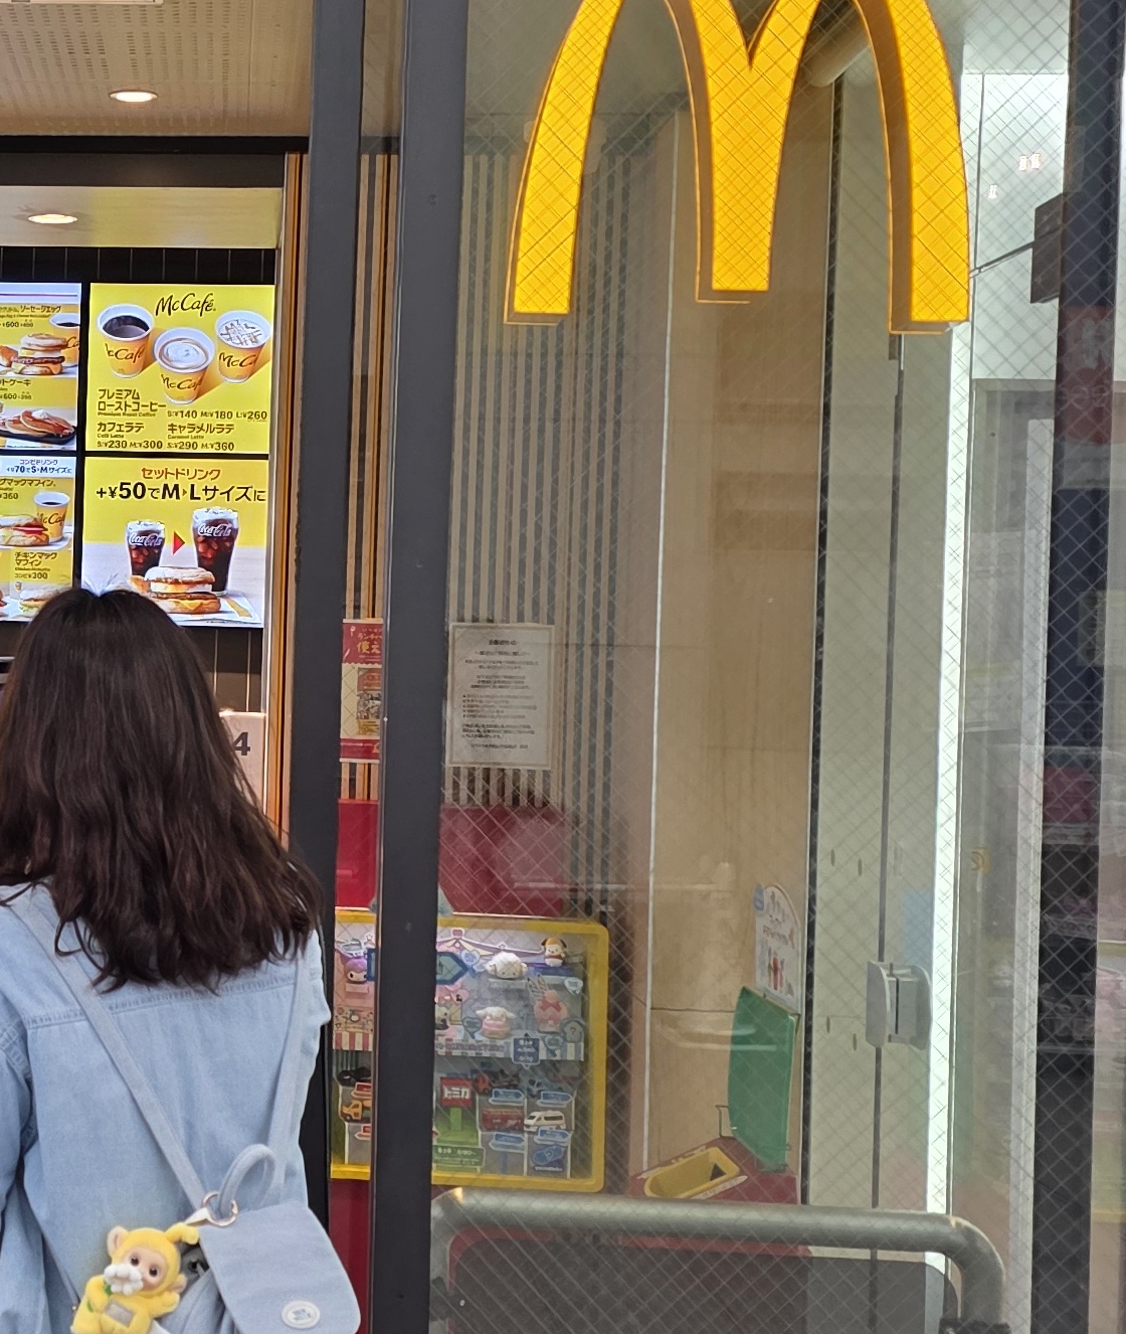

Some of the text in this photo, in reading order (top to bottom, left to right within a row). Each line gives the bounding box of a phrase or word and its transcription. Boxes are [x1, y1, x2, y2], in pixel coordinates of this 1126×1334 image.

[20, 305, 61, 313] ソーセージエッグ
[98, 389, 140, 399] プレミアム
[98, 401, 166, 412] ローストコーヒー
[97, 422, 144, 433] カフェラテ
[167, 423, 235, 434] キャラメルラテ
[142, 468, 221, 481] セットドリンク
[15, 559, 42, 567] マフィン
[444, 1086, 470, 1099] トミカ
